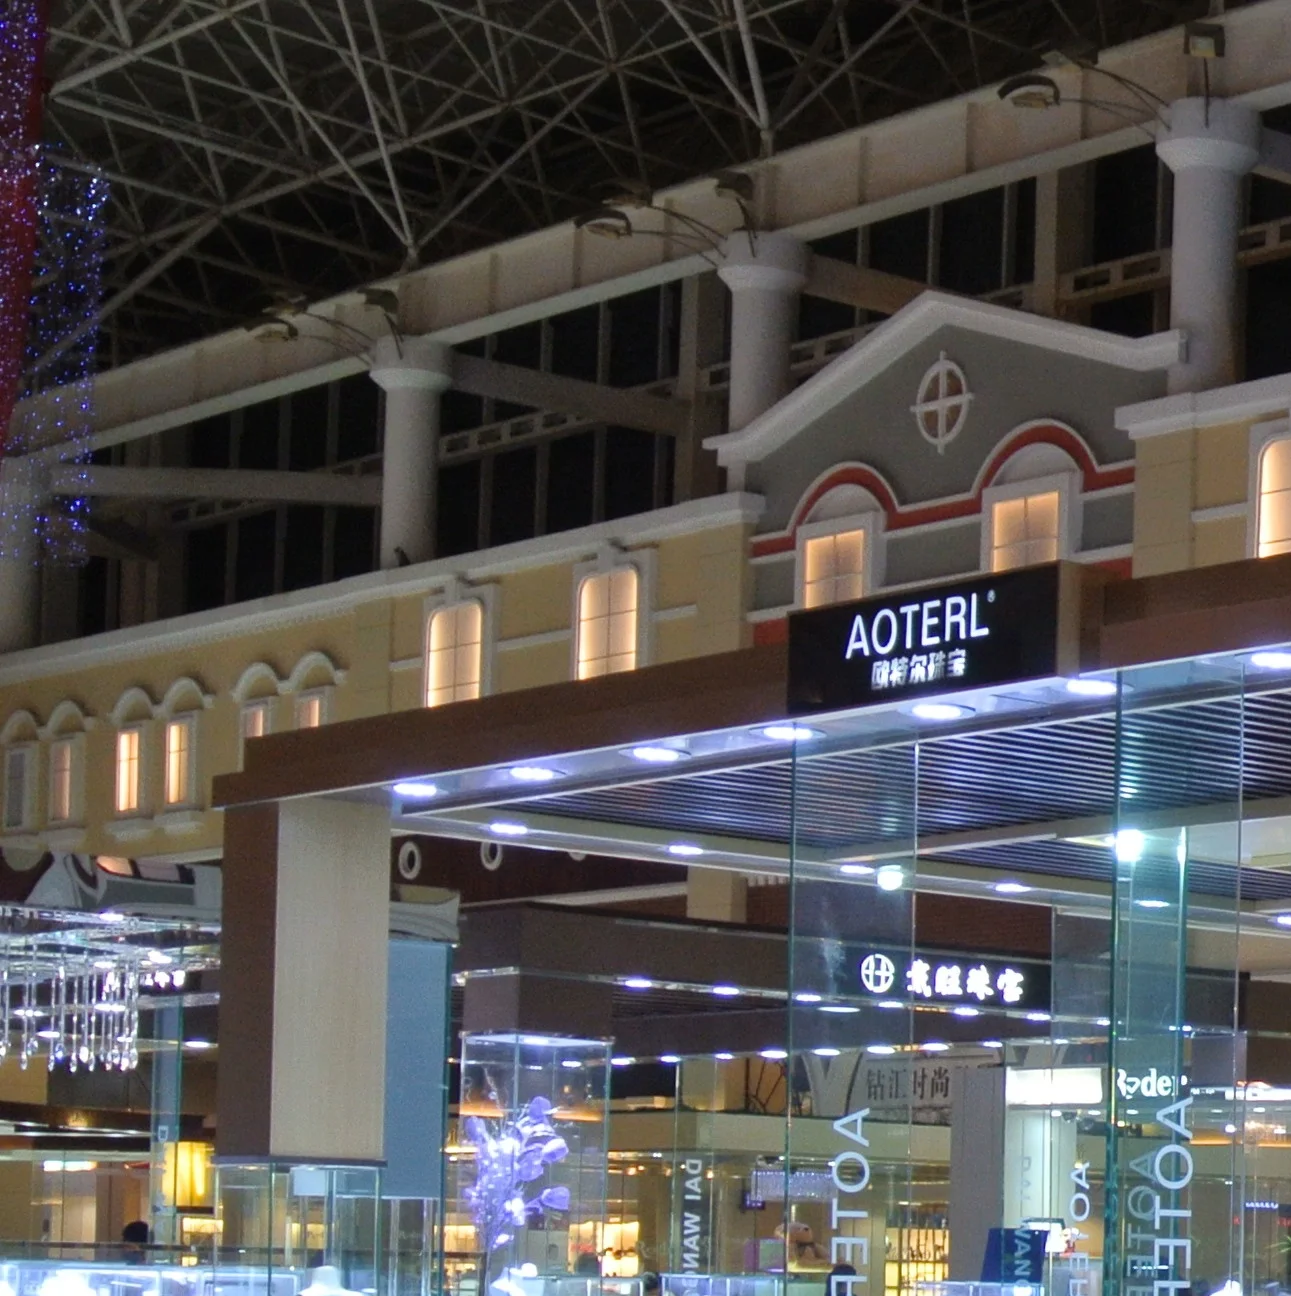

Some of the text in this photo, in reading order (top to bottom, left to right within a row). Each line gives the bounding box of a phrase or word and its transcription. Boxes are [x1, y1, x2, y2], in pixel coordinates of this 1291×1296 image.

[845, 592, 989, 659] AOTERL
[871, 648, 966, 690] 欧特尔珠宝
